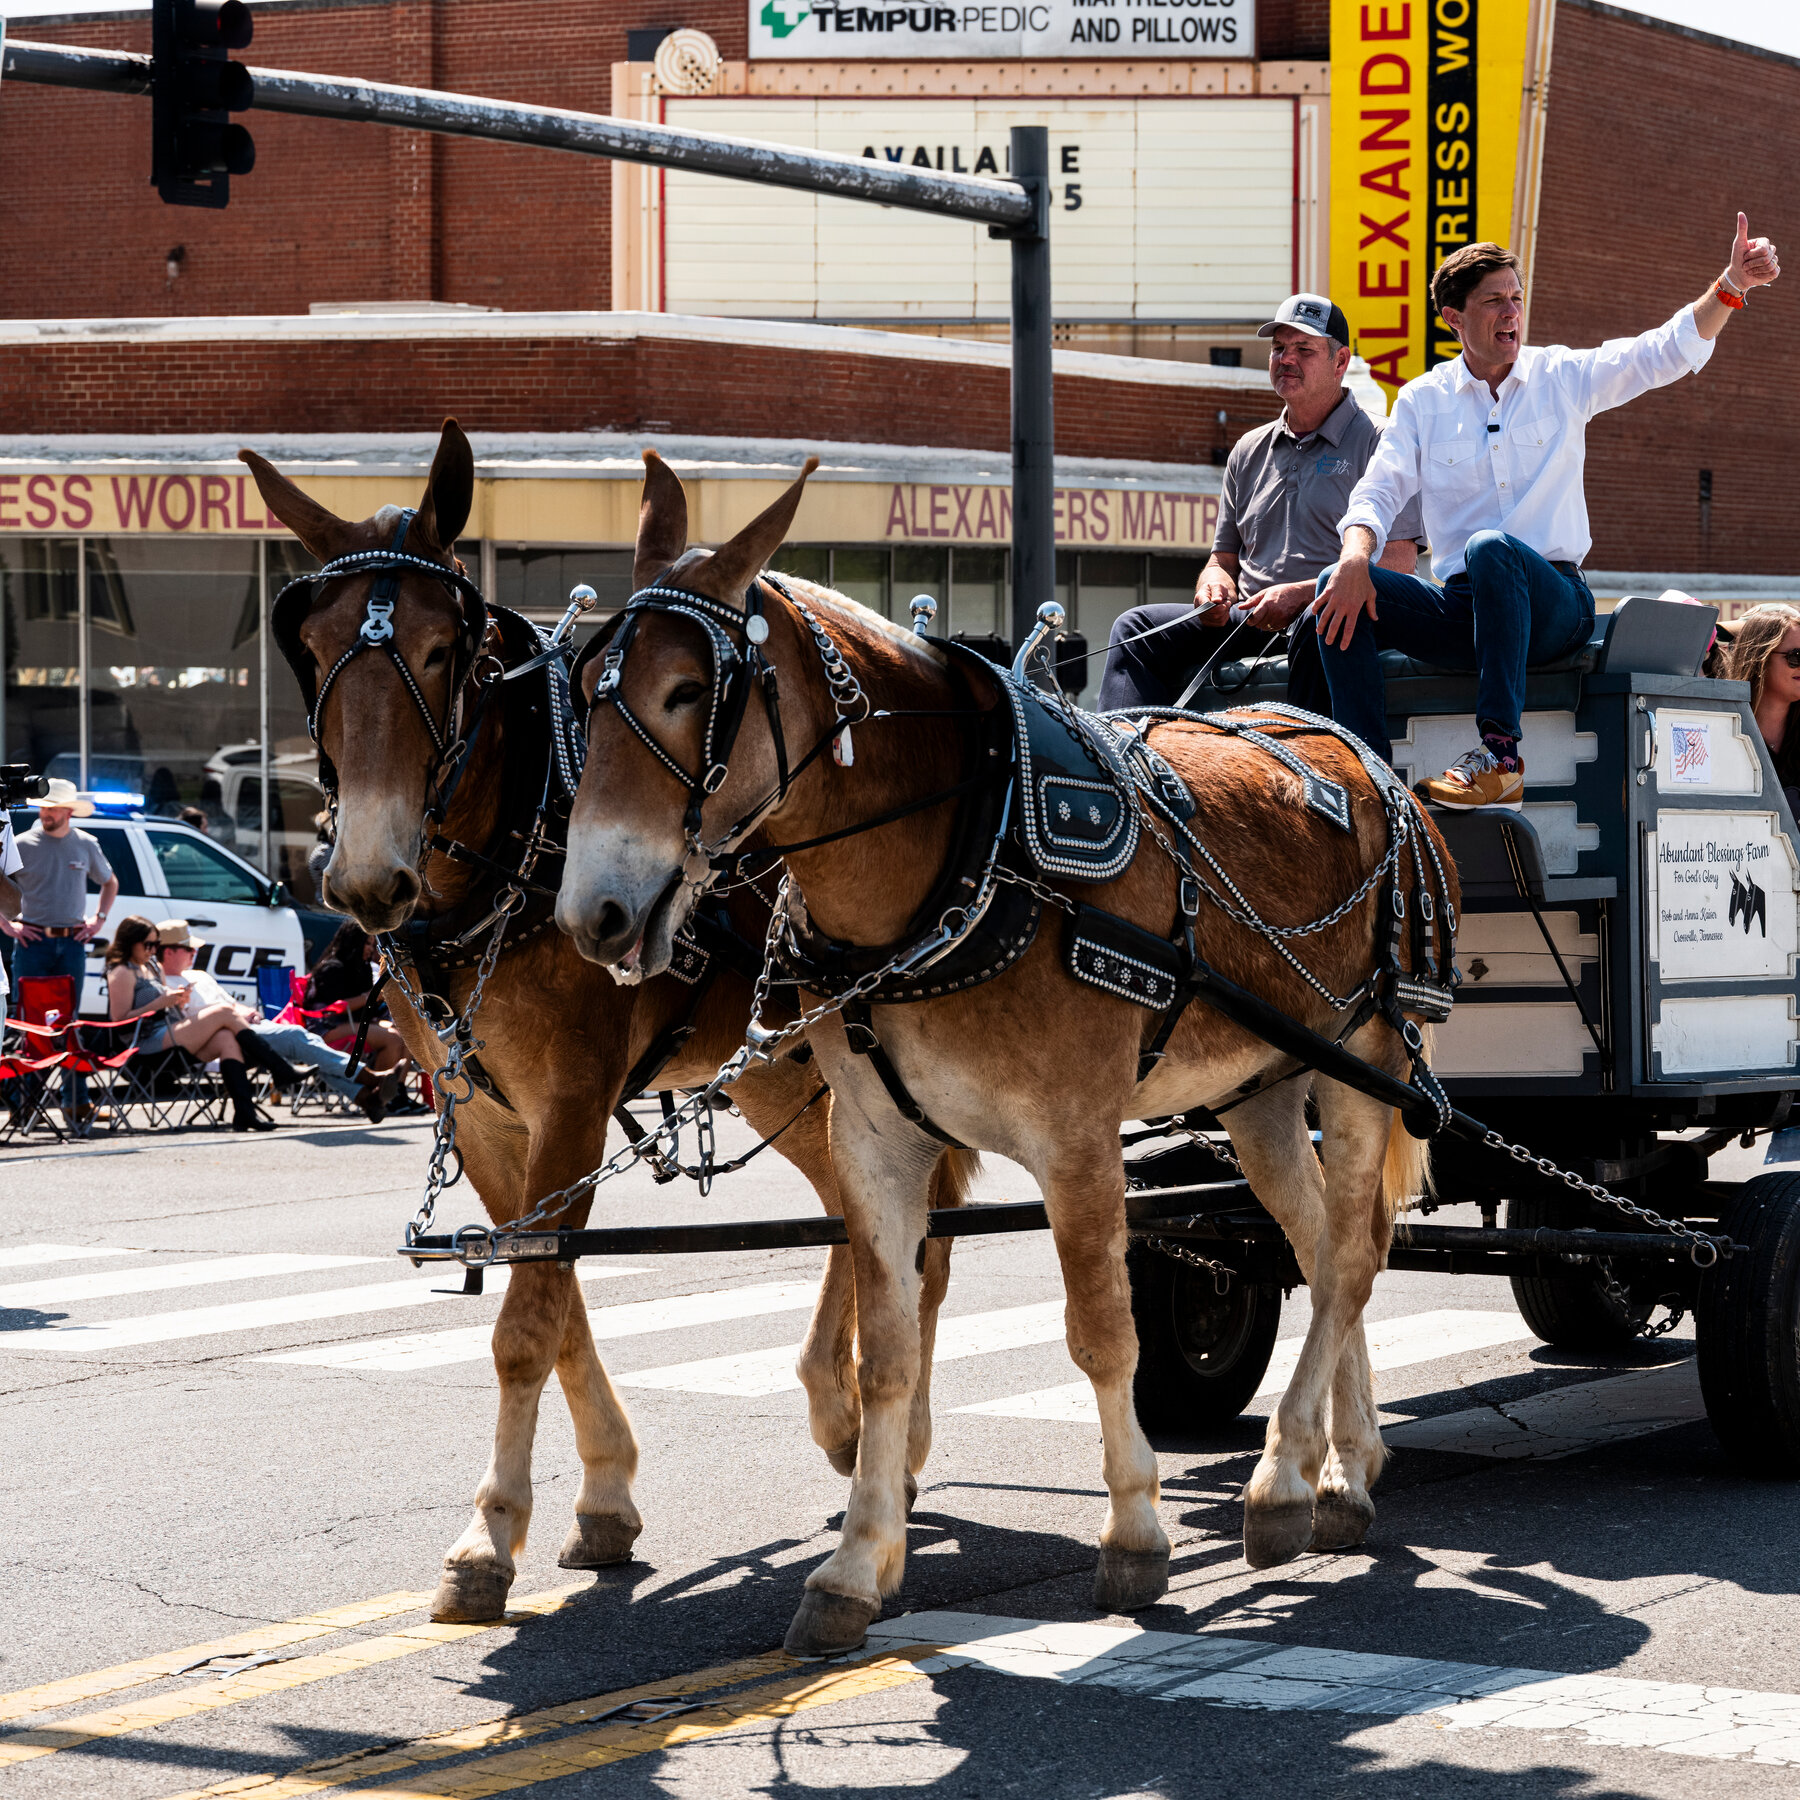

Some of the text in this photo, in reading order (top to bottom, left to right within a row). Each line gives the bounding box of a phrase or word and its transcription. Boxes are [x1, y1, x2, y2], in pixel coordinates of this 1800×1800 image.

[1070, 16, 1238, 43] AND PILLOWS
[1435, 0, 1470, 75] WO
[1358, 2, 1411, 388] ALEXANDE
[0, 474, 290, 530] ESS WORL
[885, 484, 1109, 541] ALEXANERS
[1659, 841, 1769, 872] Abundant Blessings Farm
[1673, 869, 1719, 889] For God's Glory
[1661, 908, 1672, 923] Bob
[1672, 908, 1684, 921] and
[1684, 908, 1699, 921] Anna
[1699, 928, 1723, 942] Tennessee
